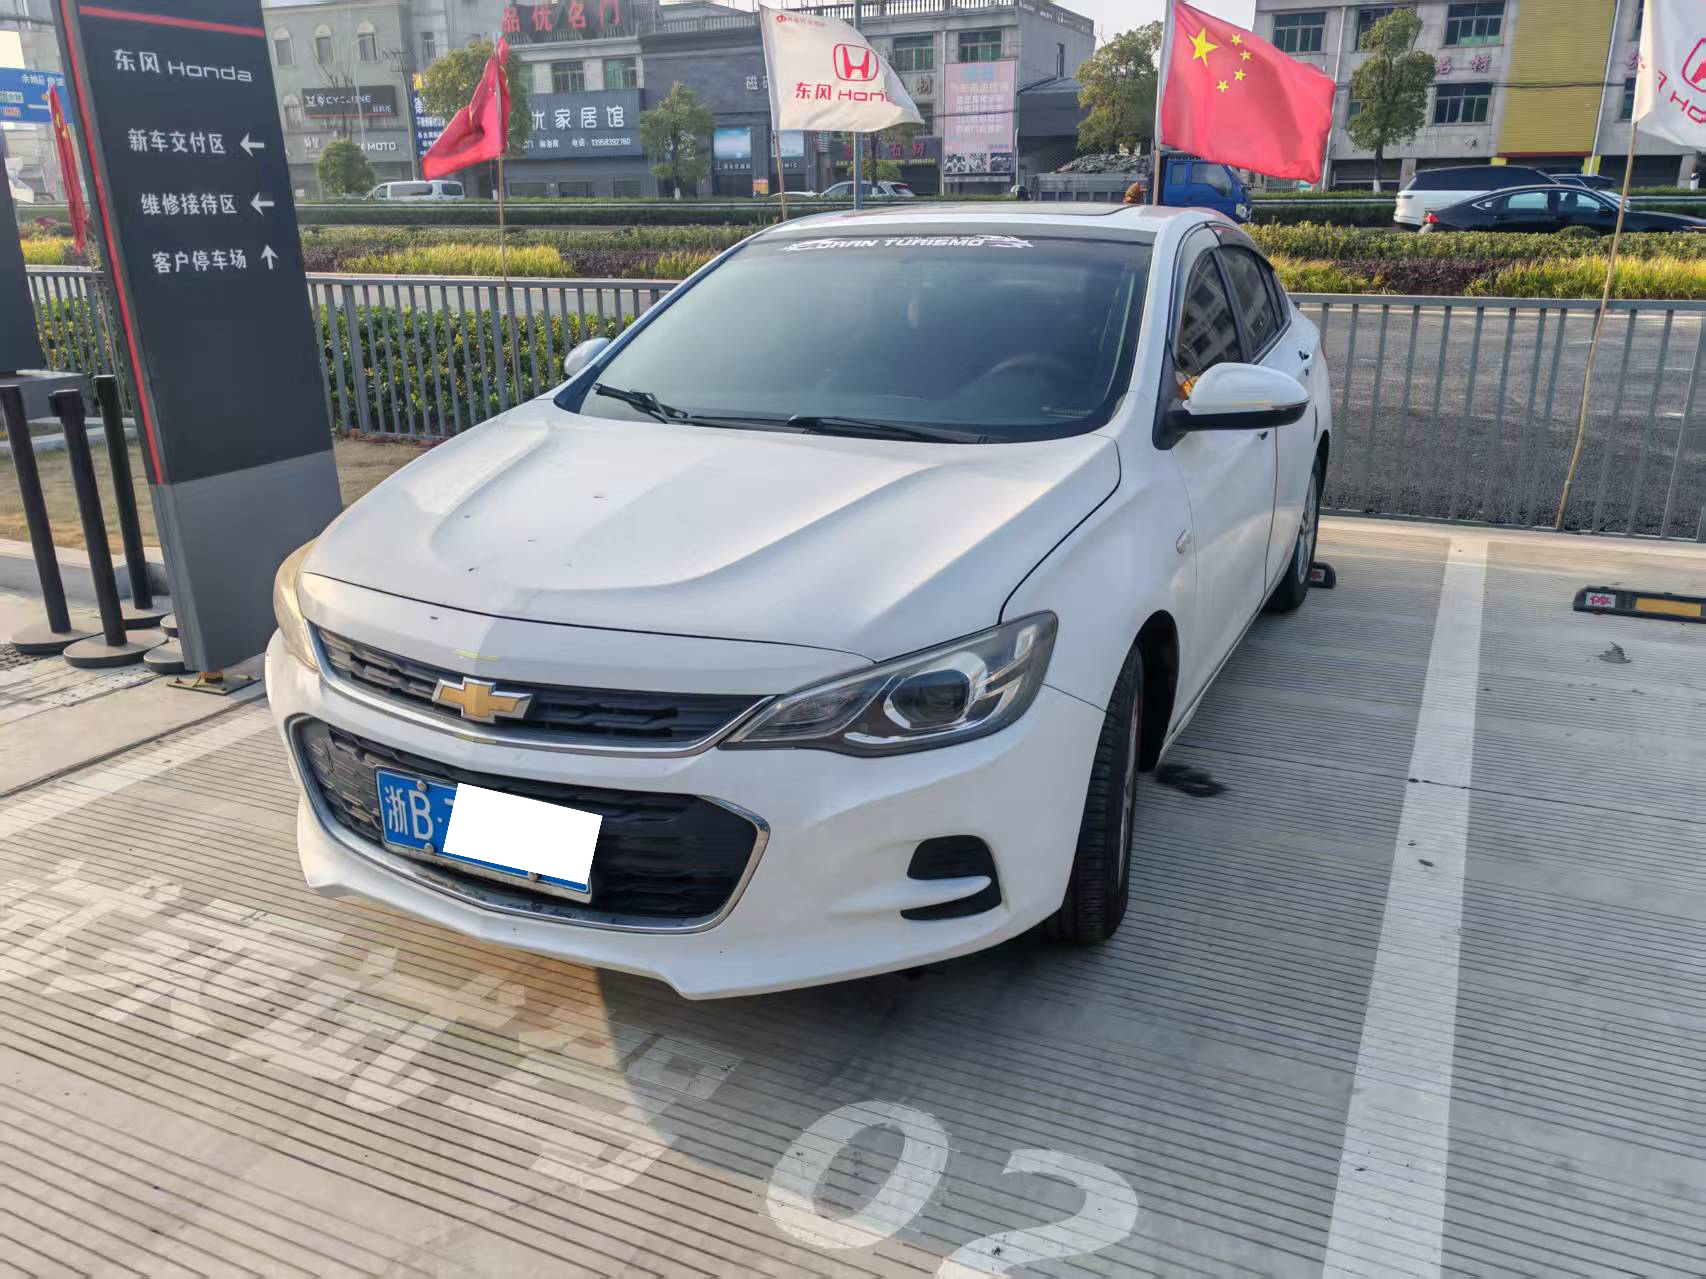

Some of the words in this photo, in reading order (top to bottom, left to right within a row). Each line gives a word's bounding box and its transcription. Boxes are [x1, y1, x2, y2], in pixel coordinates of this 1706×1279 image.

[113, 48, 160, 74] 东风
[168, 60, 252, 82] Honda
[795, 81, 831, 101] 东风
[838, 88, 890, 102] Hon
[128, 129, 227, 154] 新车交付区
[140, 193, 237, 217] 维修接待区
[151, 248, 247, 274] 客户停车场
